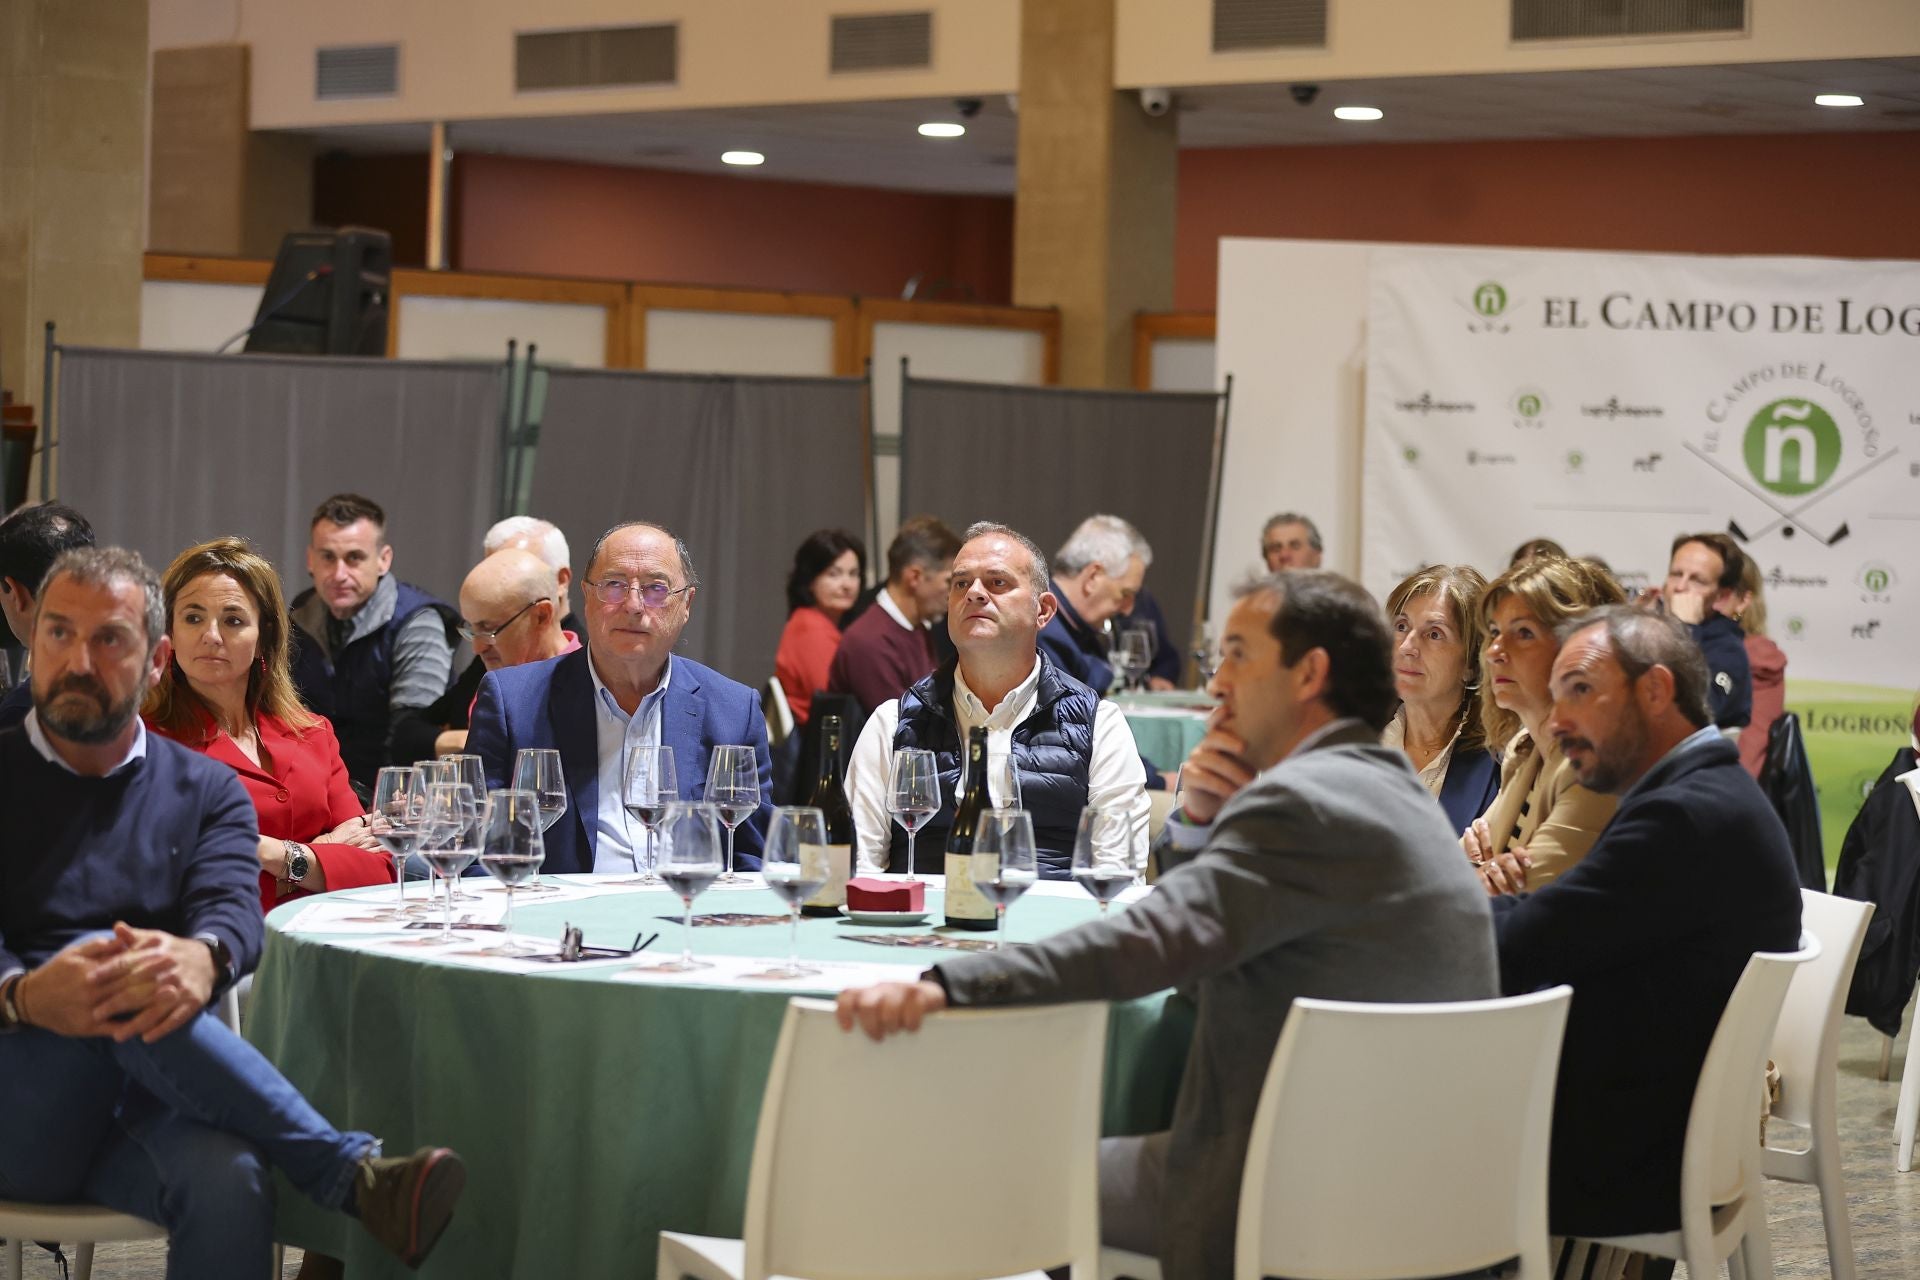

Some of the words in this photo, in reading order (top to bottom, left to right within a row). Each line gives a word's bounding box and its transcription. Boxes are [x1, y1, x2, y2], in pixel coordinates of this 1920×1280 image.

[1541, 296, 1589, 329] EL
[1600, 291, 1757, 334] CAMPO
[1771, 302, 1825, 334] DE
[1781, 363, 1810, 379] DE
[1763, 403, 1817, 485] ñ
